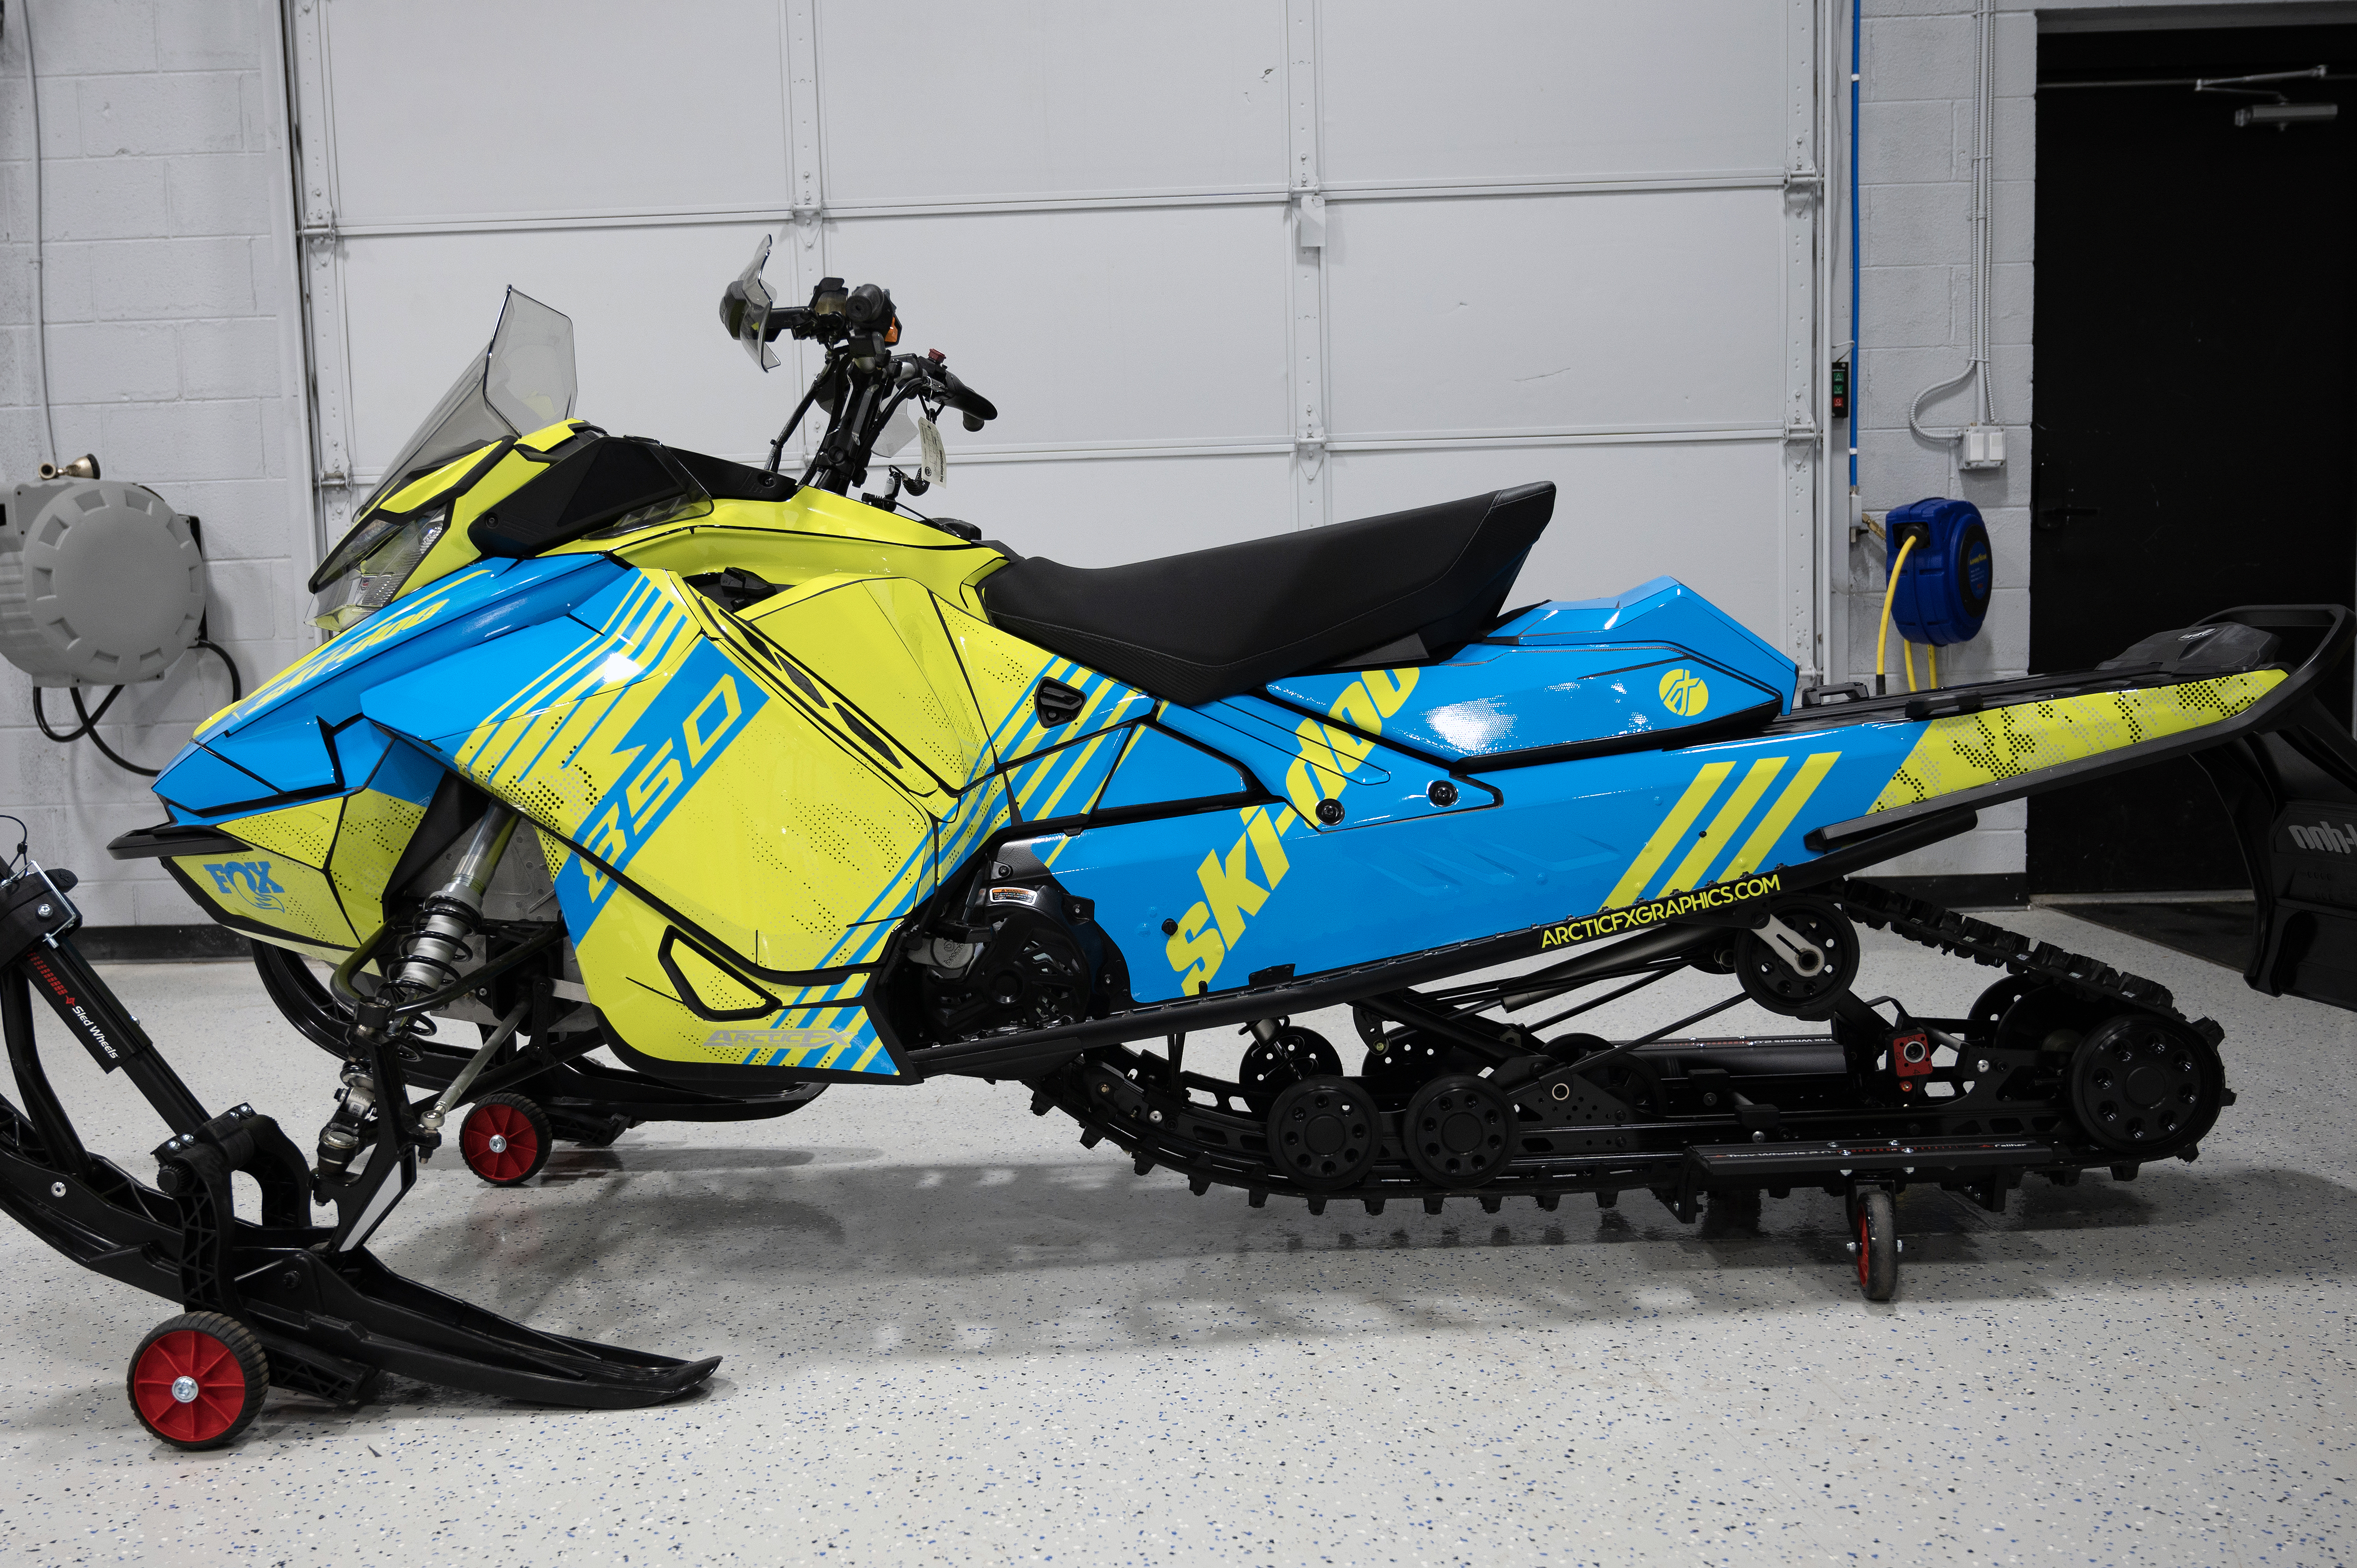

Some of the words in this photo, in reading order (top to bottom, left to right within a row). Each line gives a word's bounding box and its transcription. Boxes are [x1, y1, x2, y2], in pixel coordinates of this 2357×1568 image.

[580, 673, 742, 903] 850
[203, 861, 285, 901] FOX
[1541, 874, 1781, 949] ARCTICFXGRAPHICS.COM
[944, 943, 965, 966] bremb
[72, 1005, 94, 1026] Sled
[89, 1025, 119, 1058] Wheels
